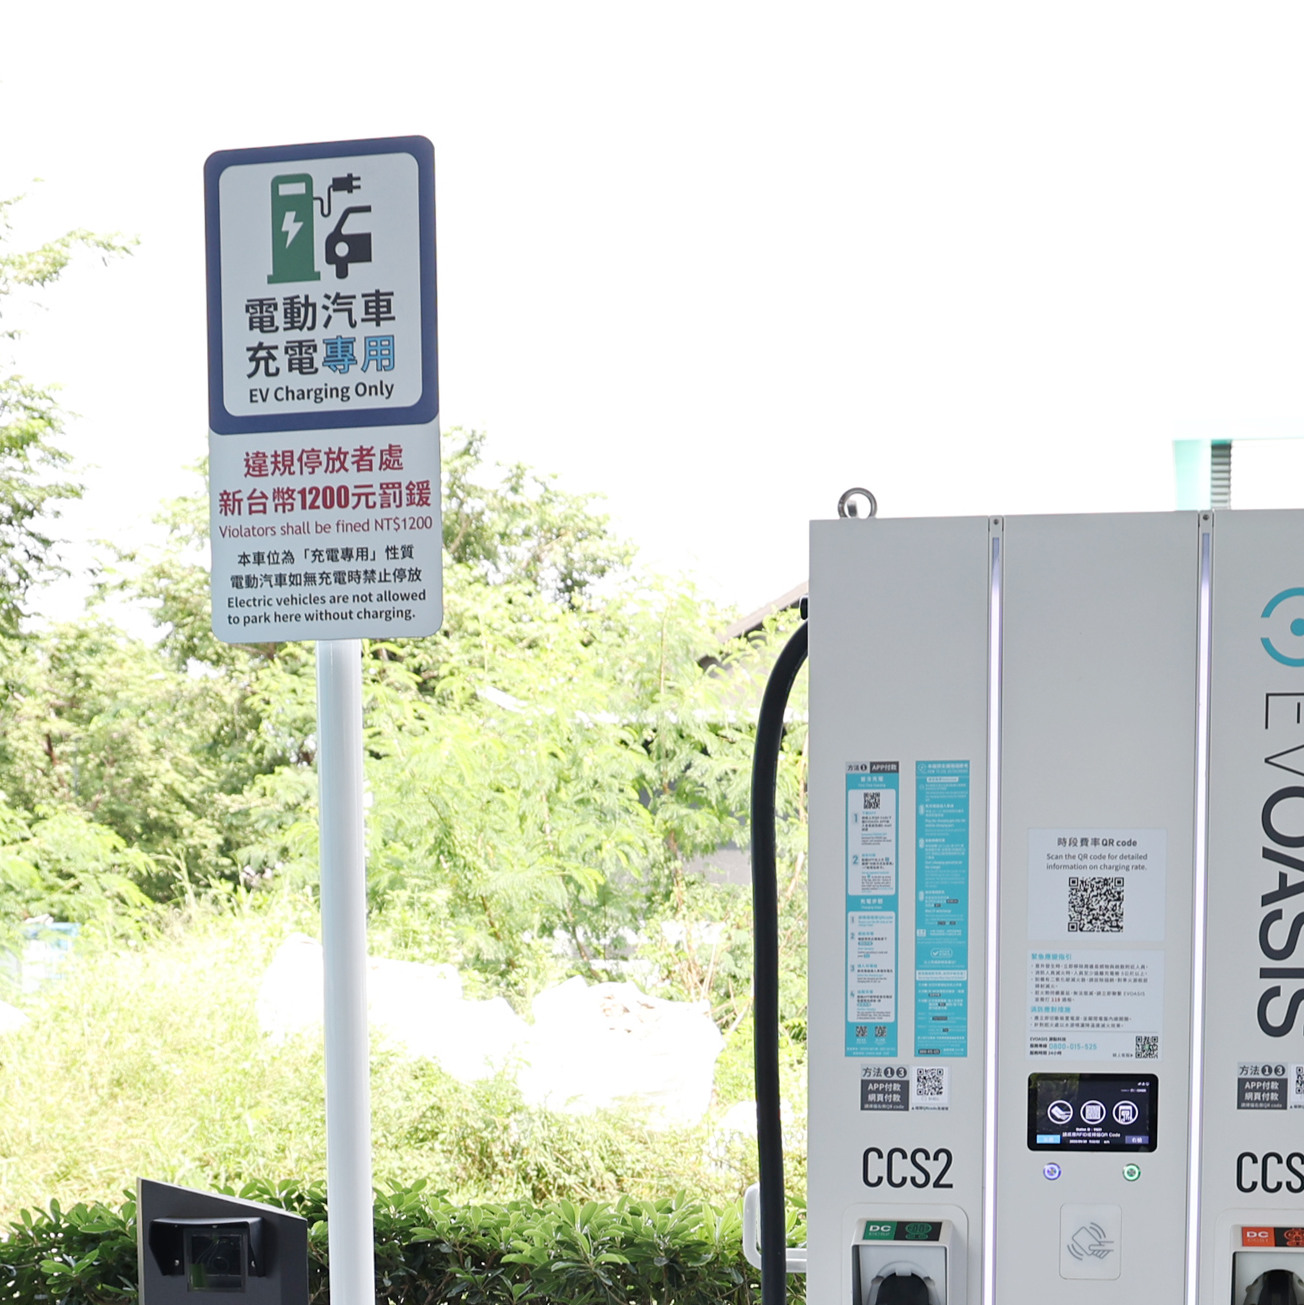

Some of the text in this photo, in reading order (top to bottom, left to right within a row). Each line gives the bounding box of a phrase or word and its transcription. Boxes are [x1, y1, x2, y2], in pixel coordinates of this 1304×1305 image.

[245, 288, 395, 334] 電動汽車
[245, 334, 395, 379] 充電專用
[249, 379, 394, 404] EV Charging Only
[243, 443, 403, 478] 違規停放者處
[218, 479, 431, 516] 新台幣1200元罰鍰
[218, 515, 433, 538] Violators shall be fined NT$1200
[230, 566, 422, 589] 電動汽車如無充電時禁止停放
[227, 588, 426, 608] Electric vehicles are not allowed
[227, 606, 415, 627] to park here without charging.
[1116, 838, 1137, 847] code
[1046, 862, 1087, 870] information
[1099, 863, 1130, 872] charging
[1077, 853, 1088, 861] QR
[1107, 852, 1117, 860] for
[868, 1082, 901, 1092] APP付款
[1245, 1081, 1279, 1091] APP付款
[862, 1147, 953, 1189] CCS2
